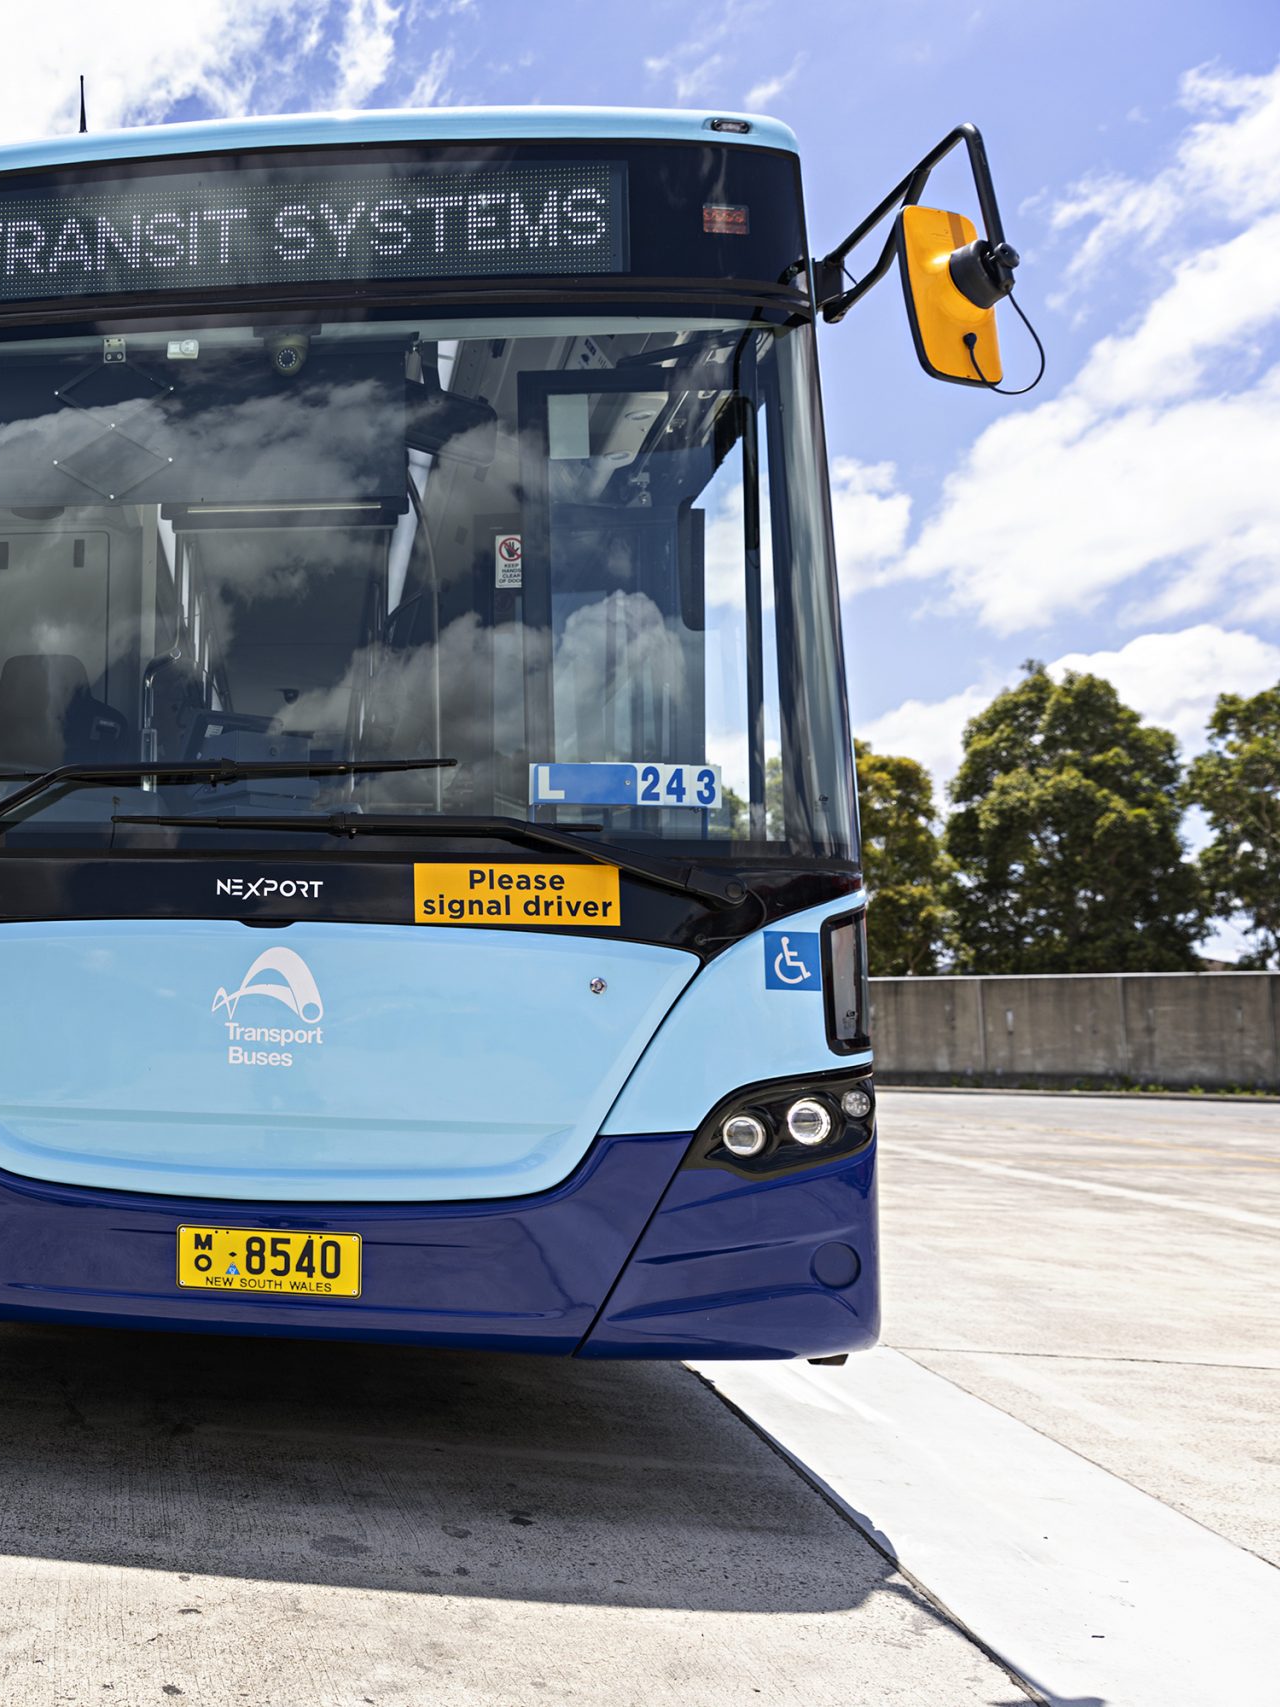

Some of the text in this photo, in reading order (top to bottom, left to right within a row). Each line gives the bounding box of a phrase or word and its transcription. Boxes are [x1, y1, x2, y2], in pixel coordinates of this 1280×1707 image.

[274, 187, 606, 261] SYSTEMS
[538, 766, 716, 805] L 243
[216, 877, 324, 900] NEXPORT
[468, 868, 566, 891] Please
[422, 894, 613, 919] signal driver
[225, 1022, 324, 1047] Transport
[228, 1046, 294, 1068] Buses
[245, 1236, 342, 1279] 8540
[205, 1276, 332, 1292] NEW SOUTH WALES
